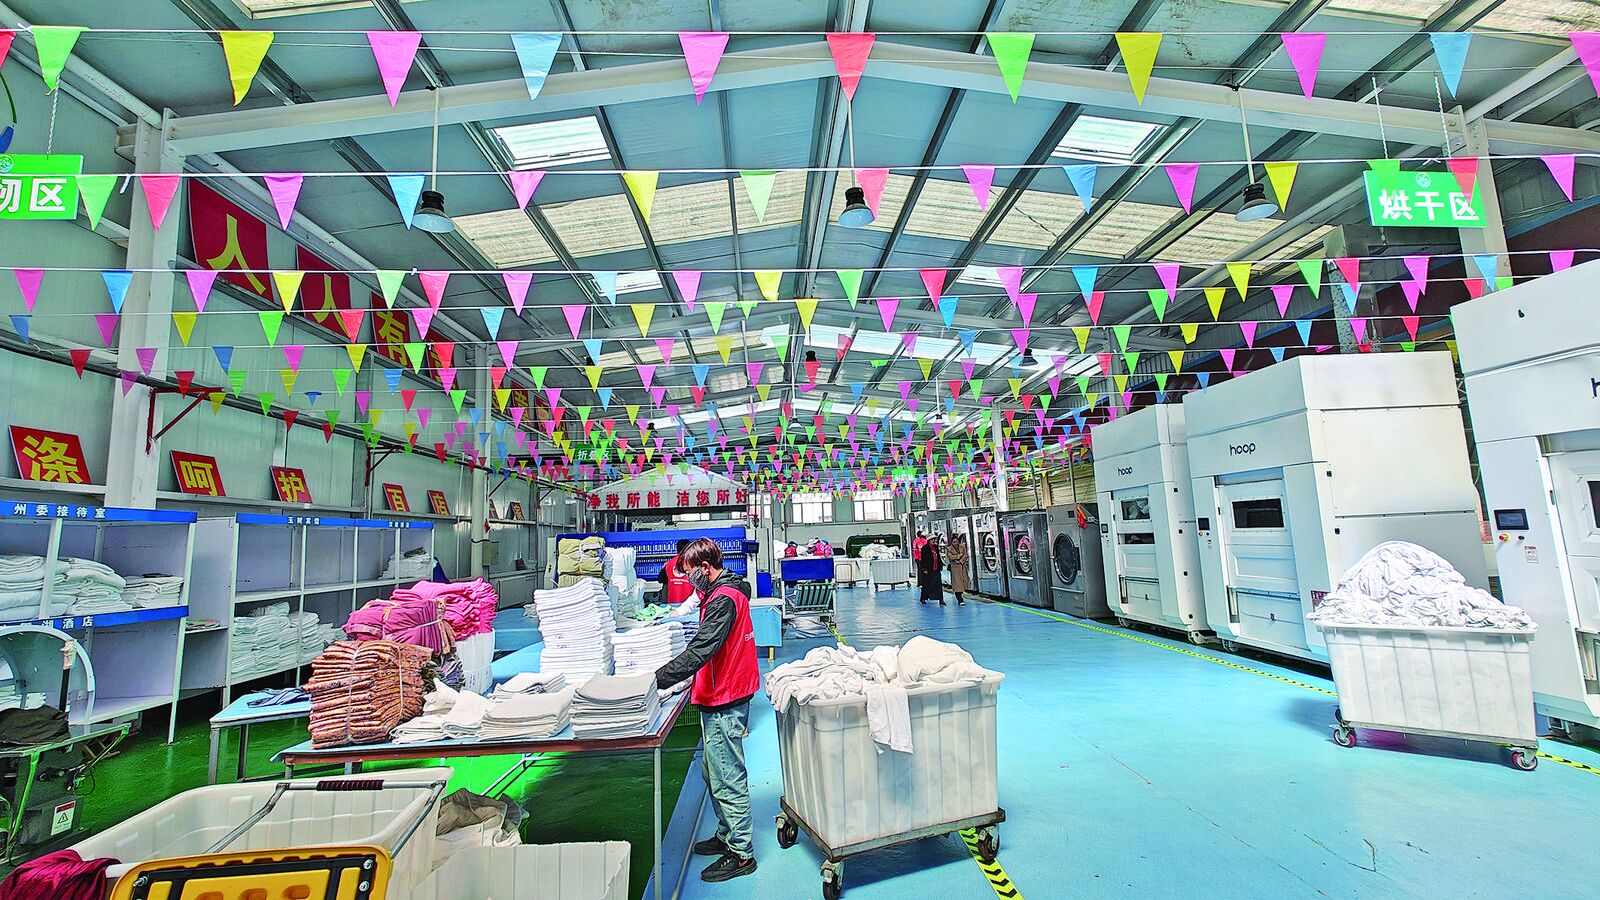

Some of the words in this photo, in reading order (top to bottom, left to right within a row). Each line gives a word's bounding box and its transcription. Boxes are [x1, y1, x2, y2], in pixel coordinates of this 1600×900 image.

[1378, 189, 1480, 221] 烘干区
[206, 213, 266, 294] 人
[22, 435, 83, 483] 涤
[1229, 443, 1256, 456] hoop
[181, 460, 217, 496] 呵
[1117, 466, 1133, 476] hoop
[277, 471, 306, 502] 护
[676, 488, 748, 506] 洁您所好
[14, 503, 106, 519] 州委接待室
[587, 491, 661, 509] 净我所能
